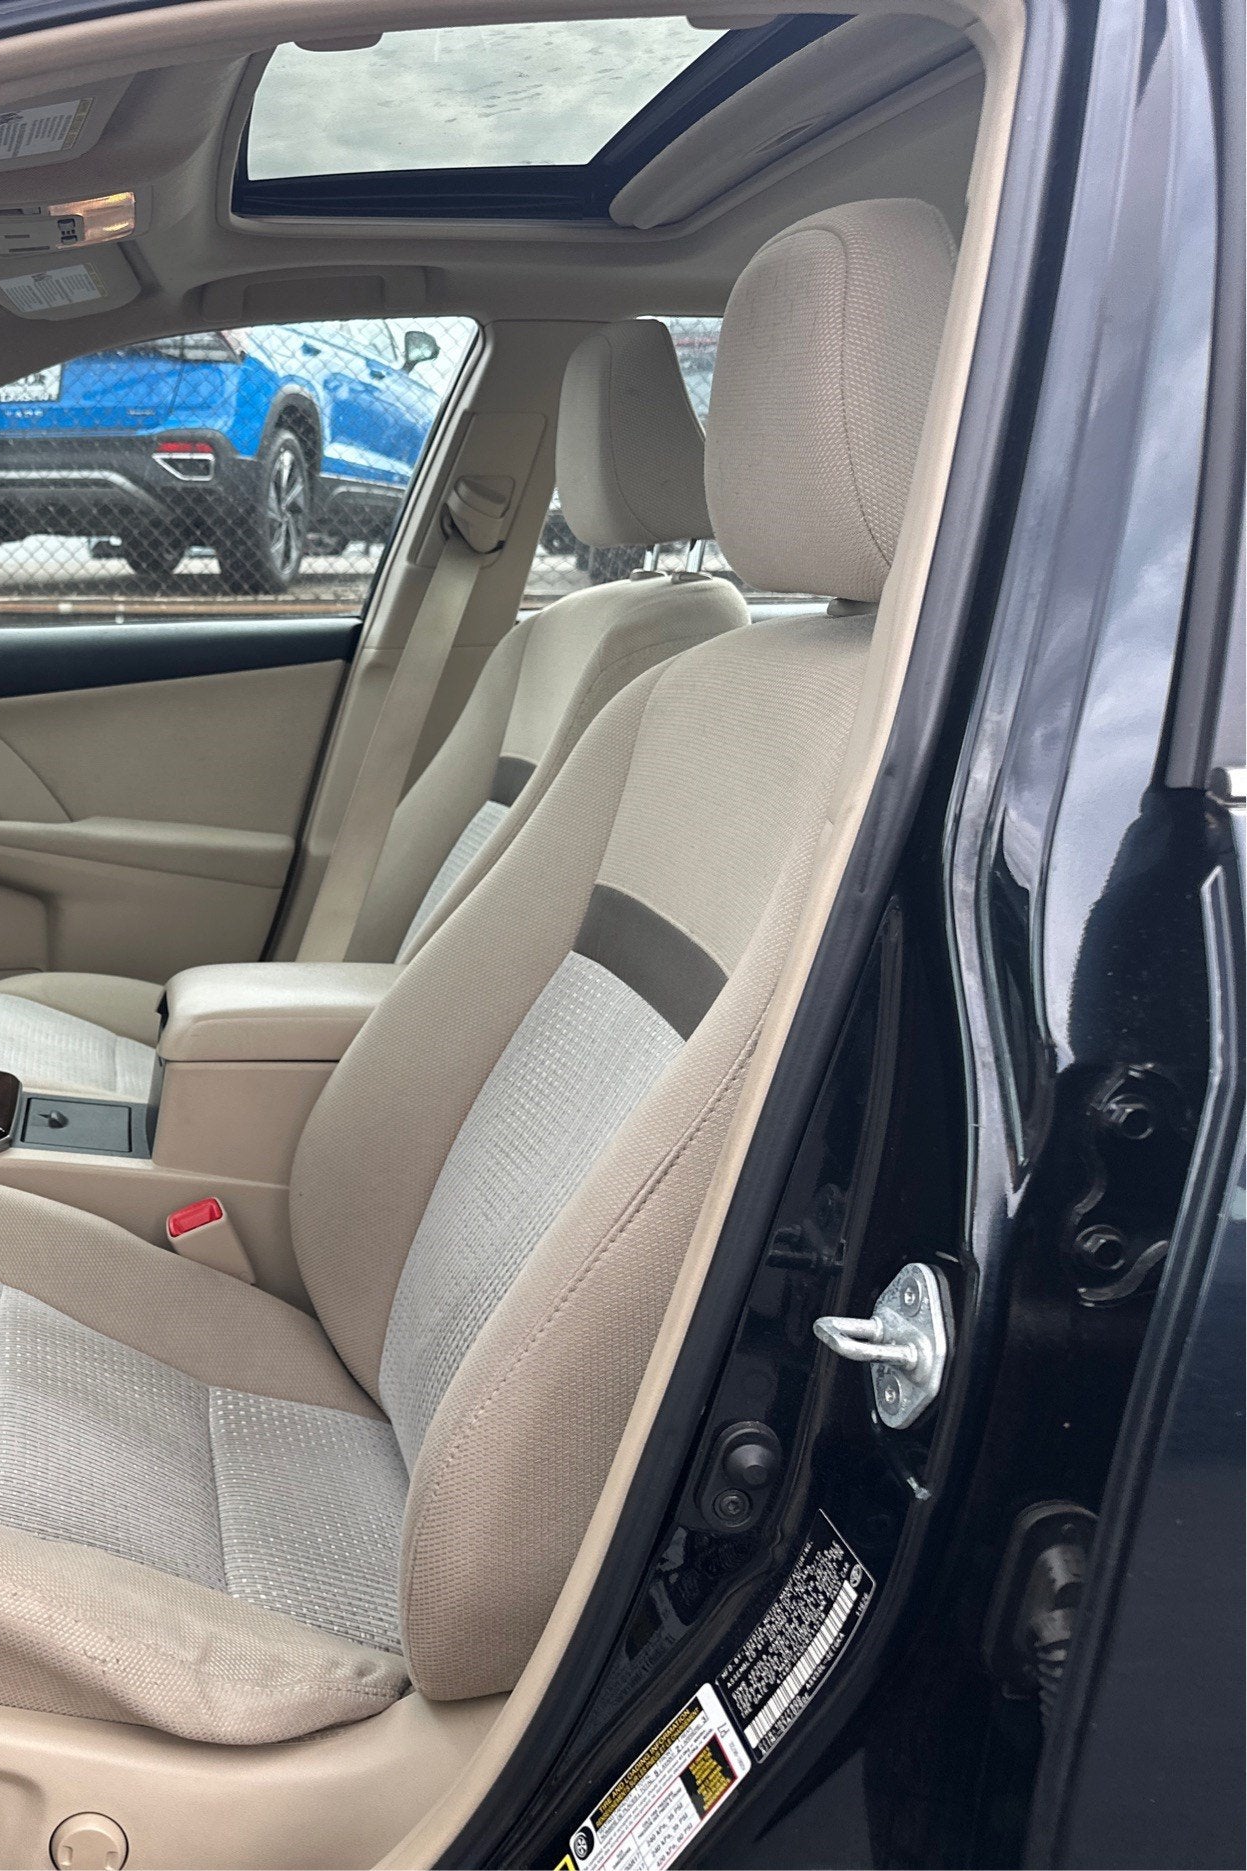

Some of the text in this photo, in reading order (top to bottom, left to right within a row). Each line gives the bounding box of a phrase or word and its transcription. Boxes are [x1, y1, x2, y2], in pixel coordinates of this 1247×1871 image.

[599, 1708, 689, 1812] TIRE AND LOADING INFORMATION
